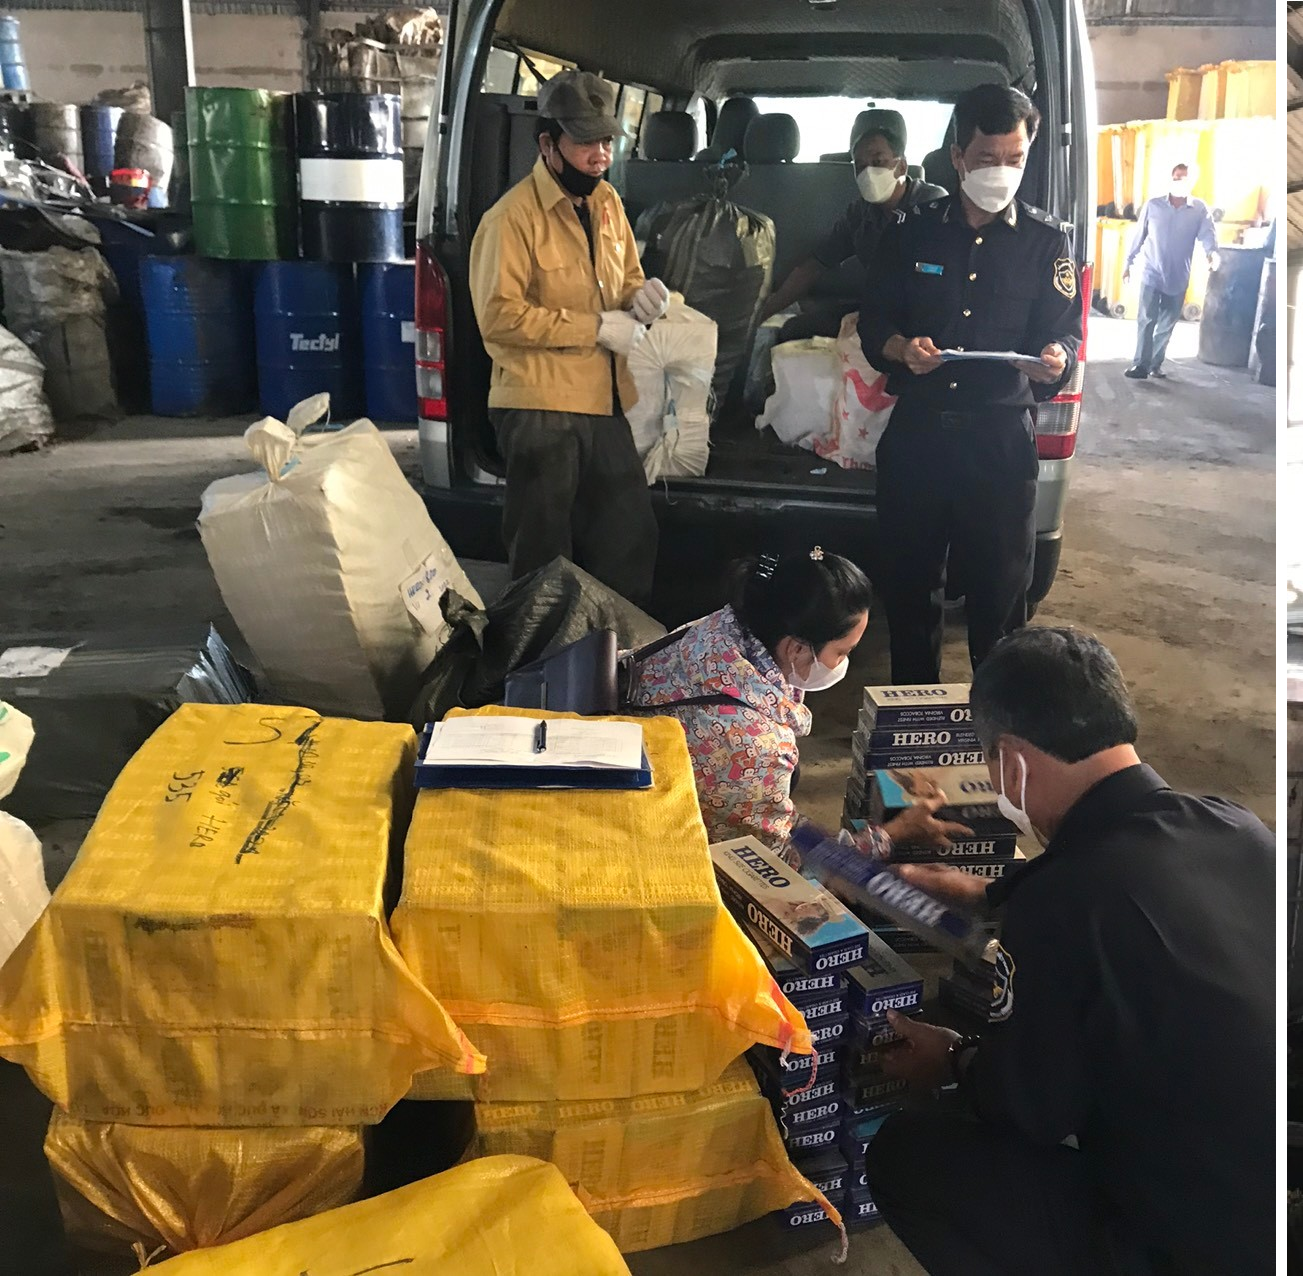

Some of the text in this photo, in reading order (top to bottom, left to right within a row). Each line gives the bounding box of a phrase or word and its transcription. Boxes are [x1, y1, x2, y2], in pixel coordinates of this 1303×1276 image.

[290, 333, 340, 352] Tectyl
[881, 688, 948, 698] HERO
[892, 731, 951, 747] HERO
[164, 769, 206, 803] 535
[190, 814, 228, 848] HERO
[730, 845, 790, 888] HERO
[747, 902, 793, 957] HERO
[815, 946, 863, 970] HERO
[783, 975, 834, 994] HERO
[872, 992, 918, 1013] HERO
[788, 1082, 835, 1106] HERO
[558, 1101, 616, 1118] HERO
[792, 1102, 839, 1123] HERO
[789, 1130, 835, 1149] HERO
